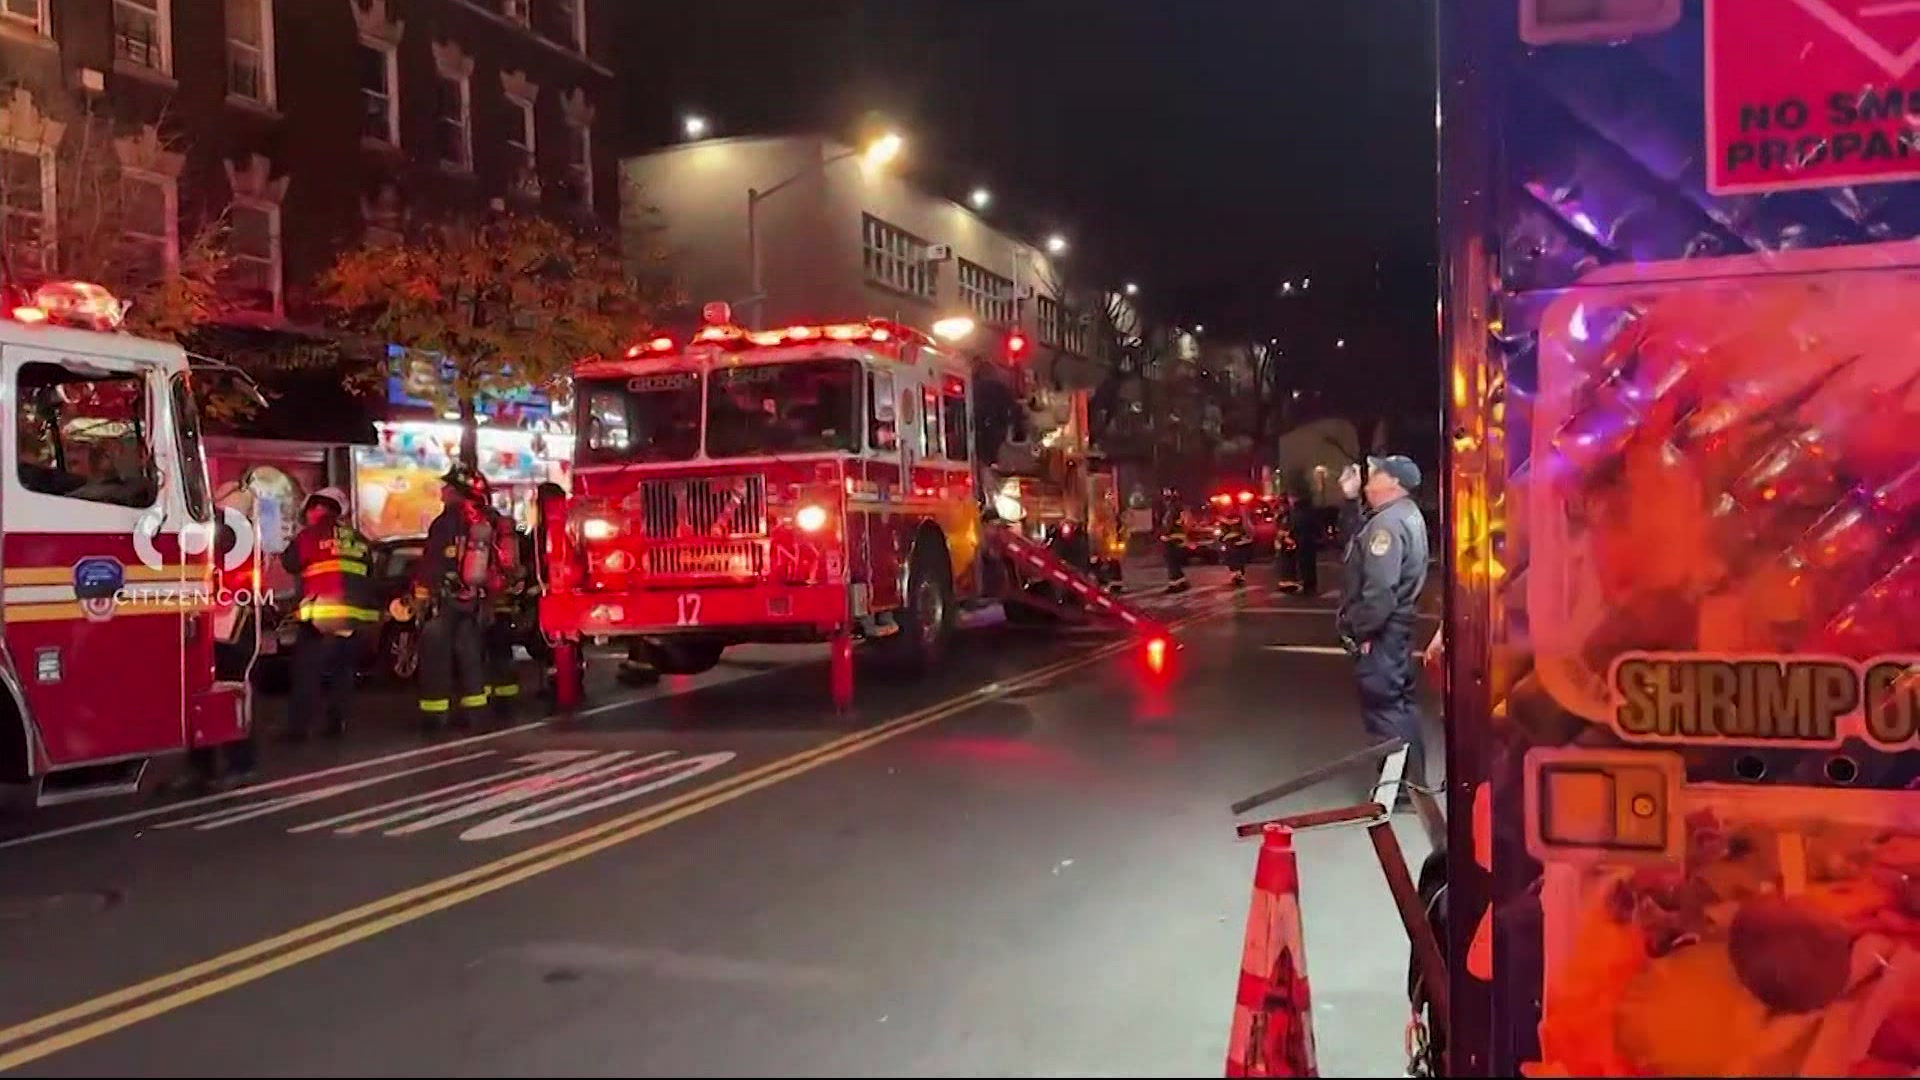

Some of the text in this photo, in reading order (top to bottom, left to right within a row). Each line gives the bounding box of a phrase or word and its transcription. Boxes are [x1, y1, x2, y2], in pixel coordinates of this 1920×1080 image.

[1740, 98, 1808, 131] NO
[676, 593, 702, 627] 17
[1616, 659, 1859, 740] SHRIMP
